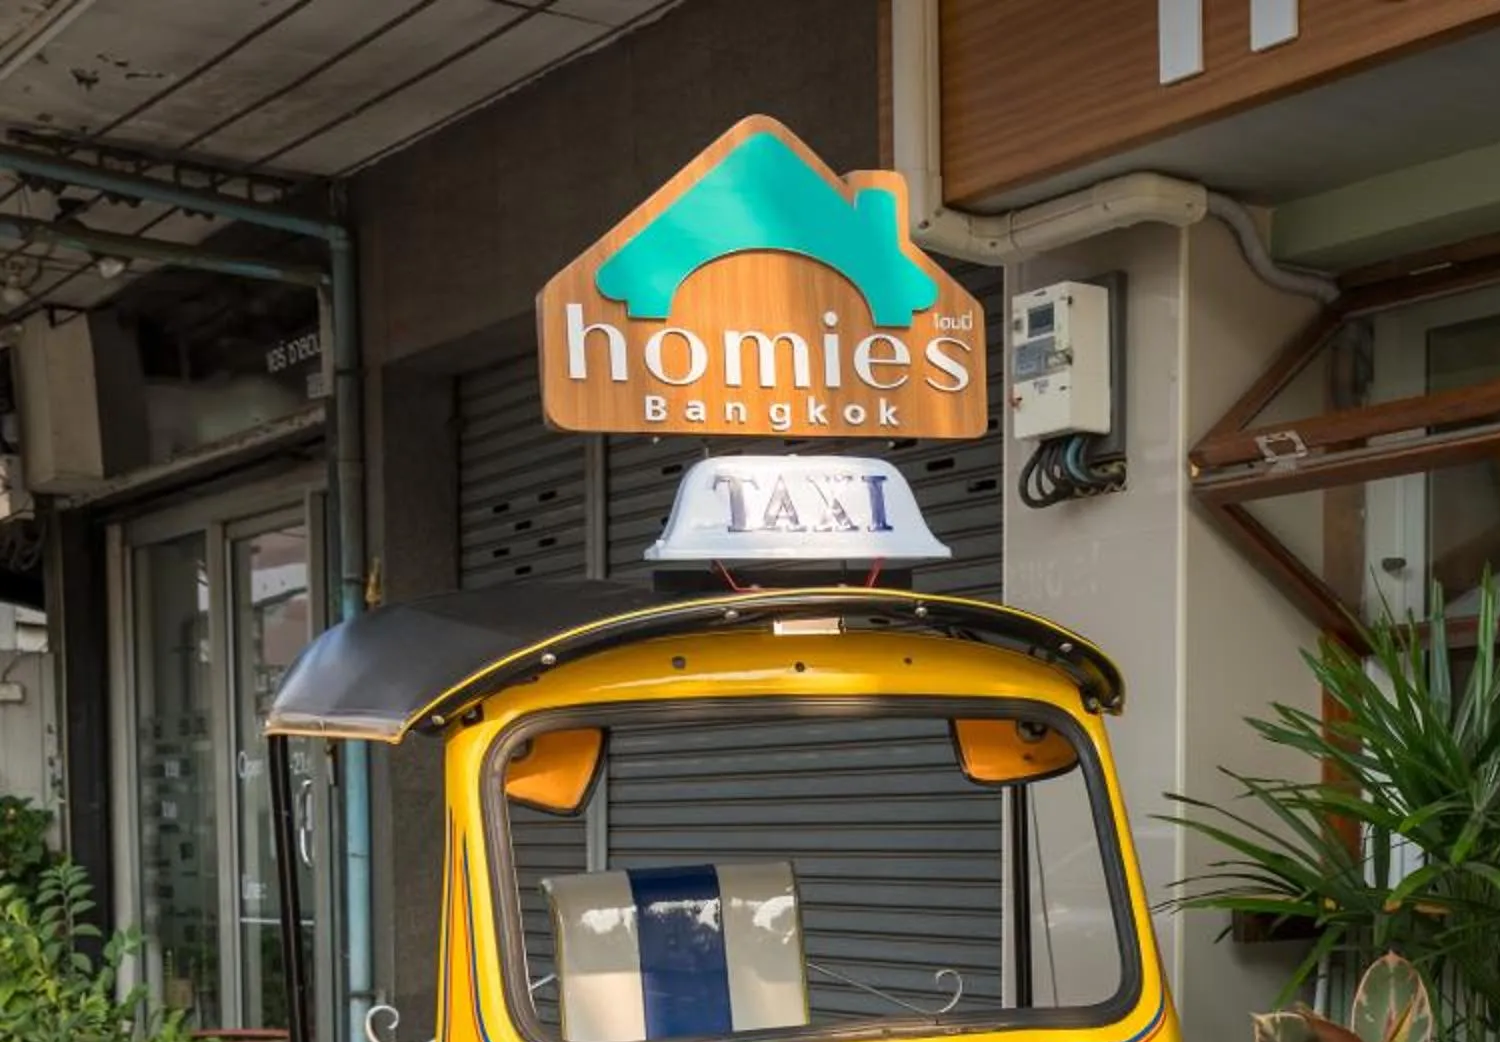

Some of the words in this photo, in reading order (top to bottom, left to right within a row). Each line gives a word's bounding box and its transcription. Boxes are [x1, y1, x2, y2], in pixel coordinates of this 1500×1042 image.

[565, 303, 973, 393] homies
[644, 395, 900, 431] Bangkok
[712, 475, 895, 533] TAXI
